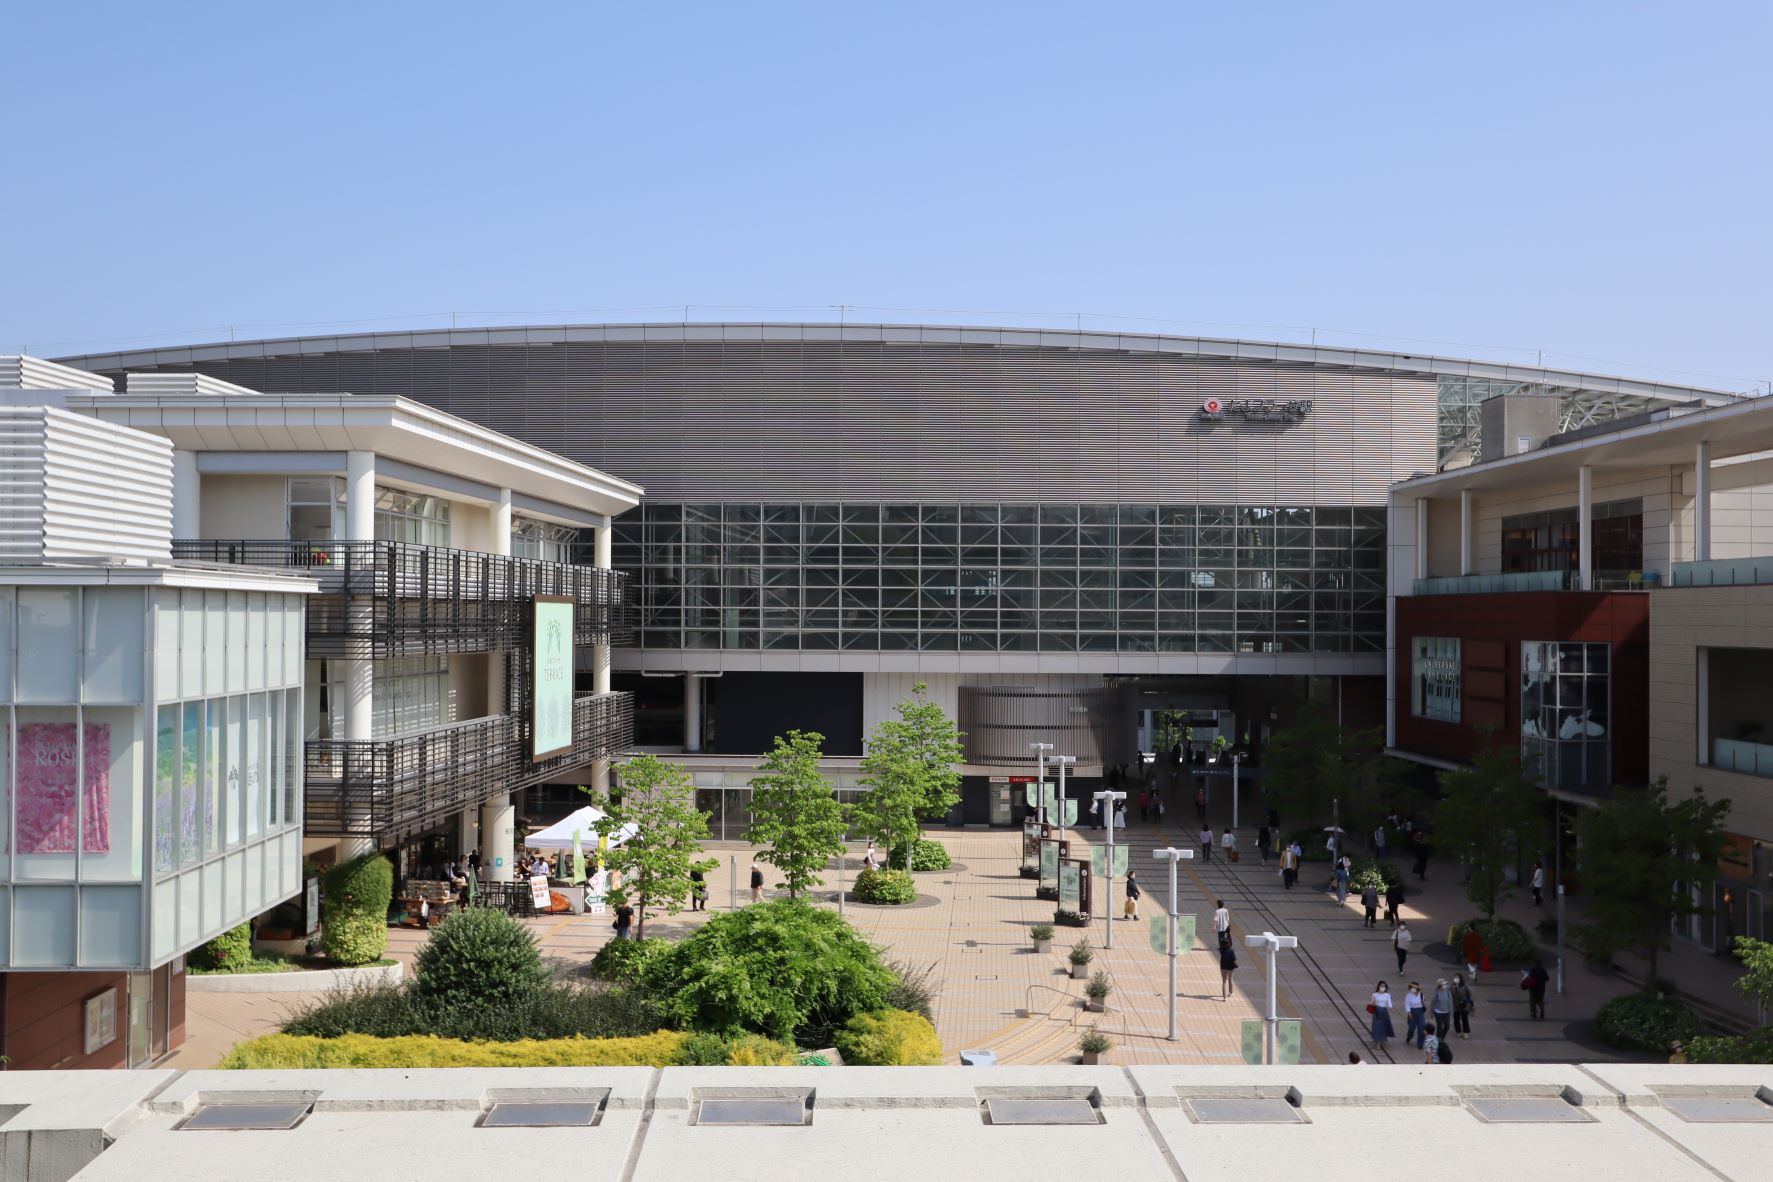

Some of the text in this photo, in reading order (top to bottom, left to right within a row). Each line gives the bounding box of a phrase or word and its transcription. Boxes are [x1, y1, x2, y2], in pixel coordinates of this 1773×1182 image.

[1229, 400, 1313, 413] たまプラーザ駅
[1424, 659, 1455, 670] UNVERSAL
